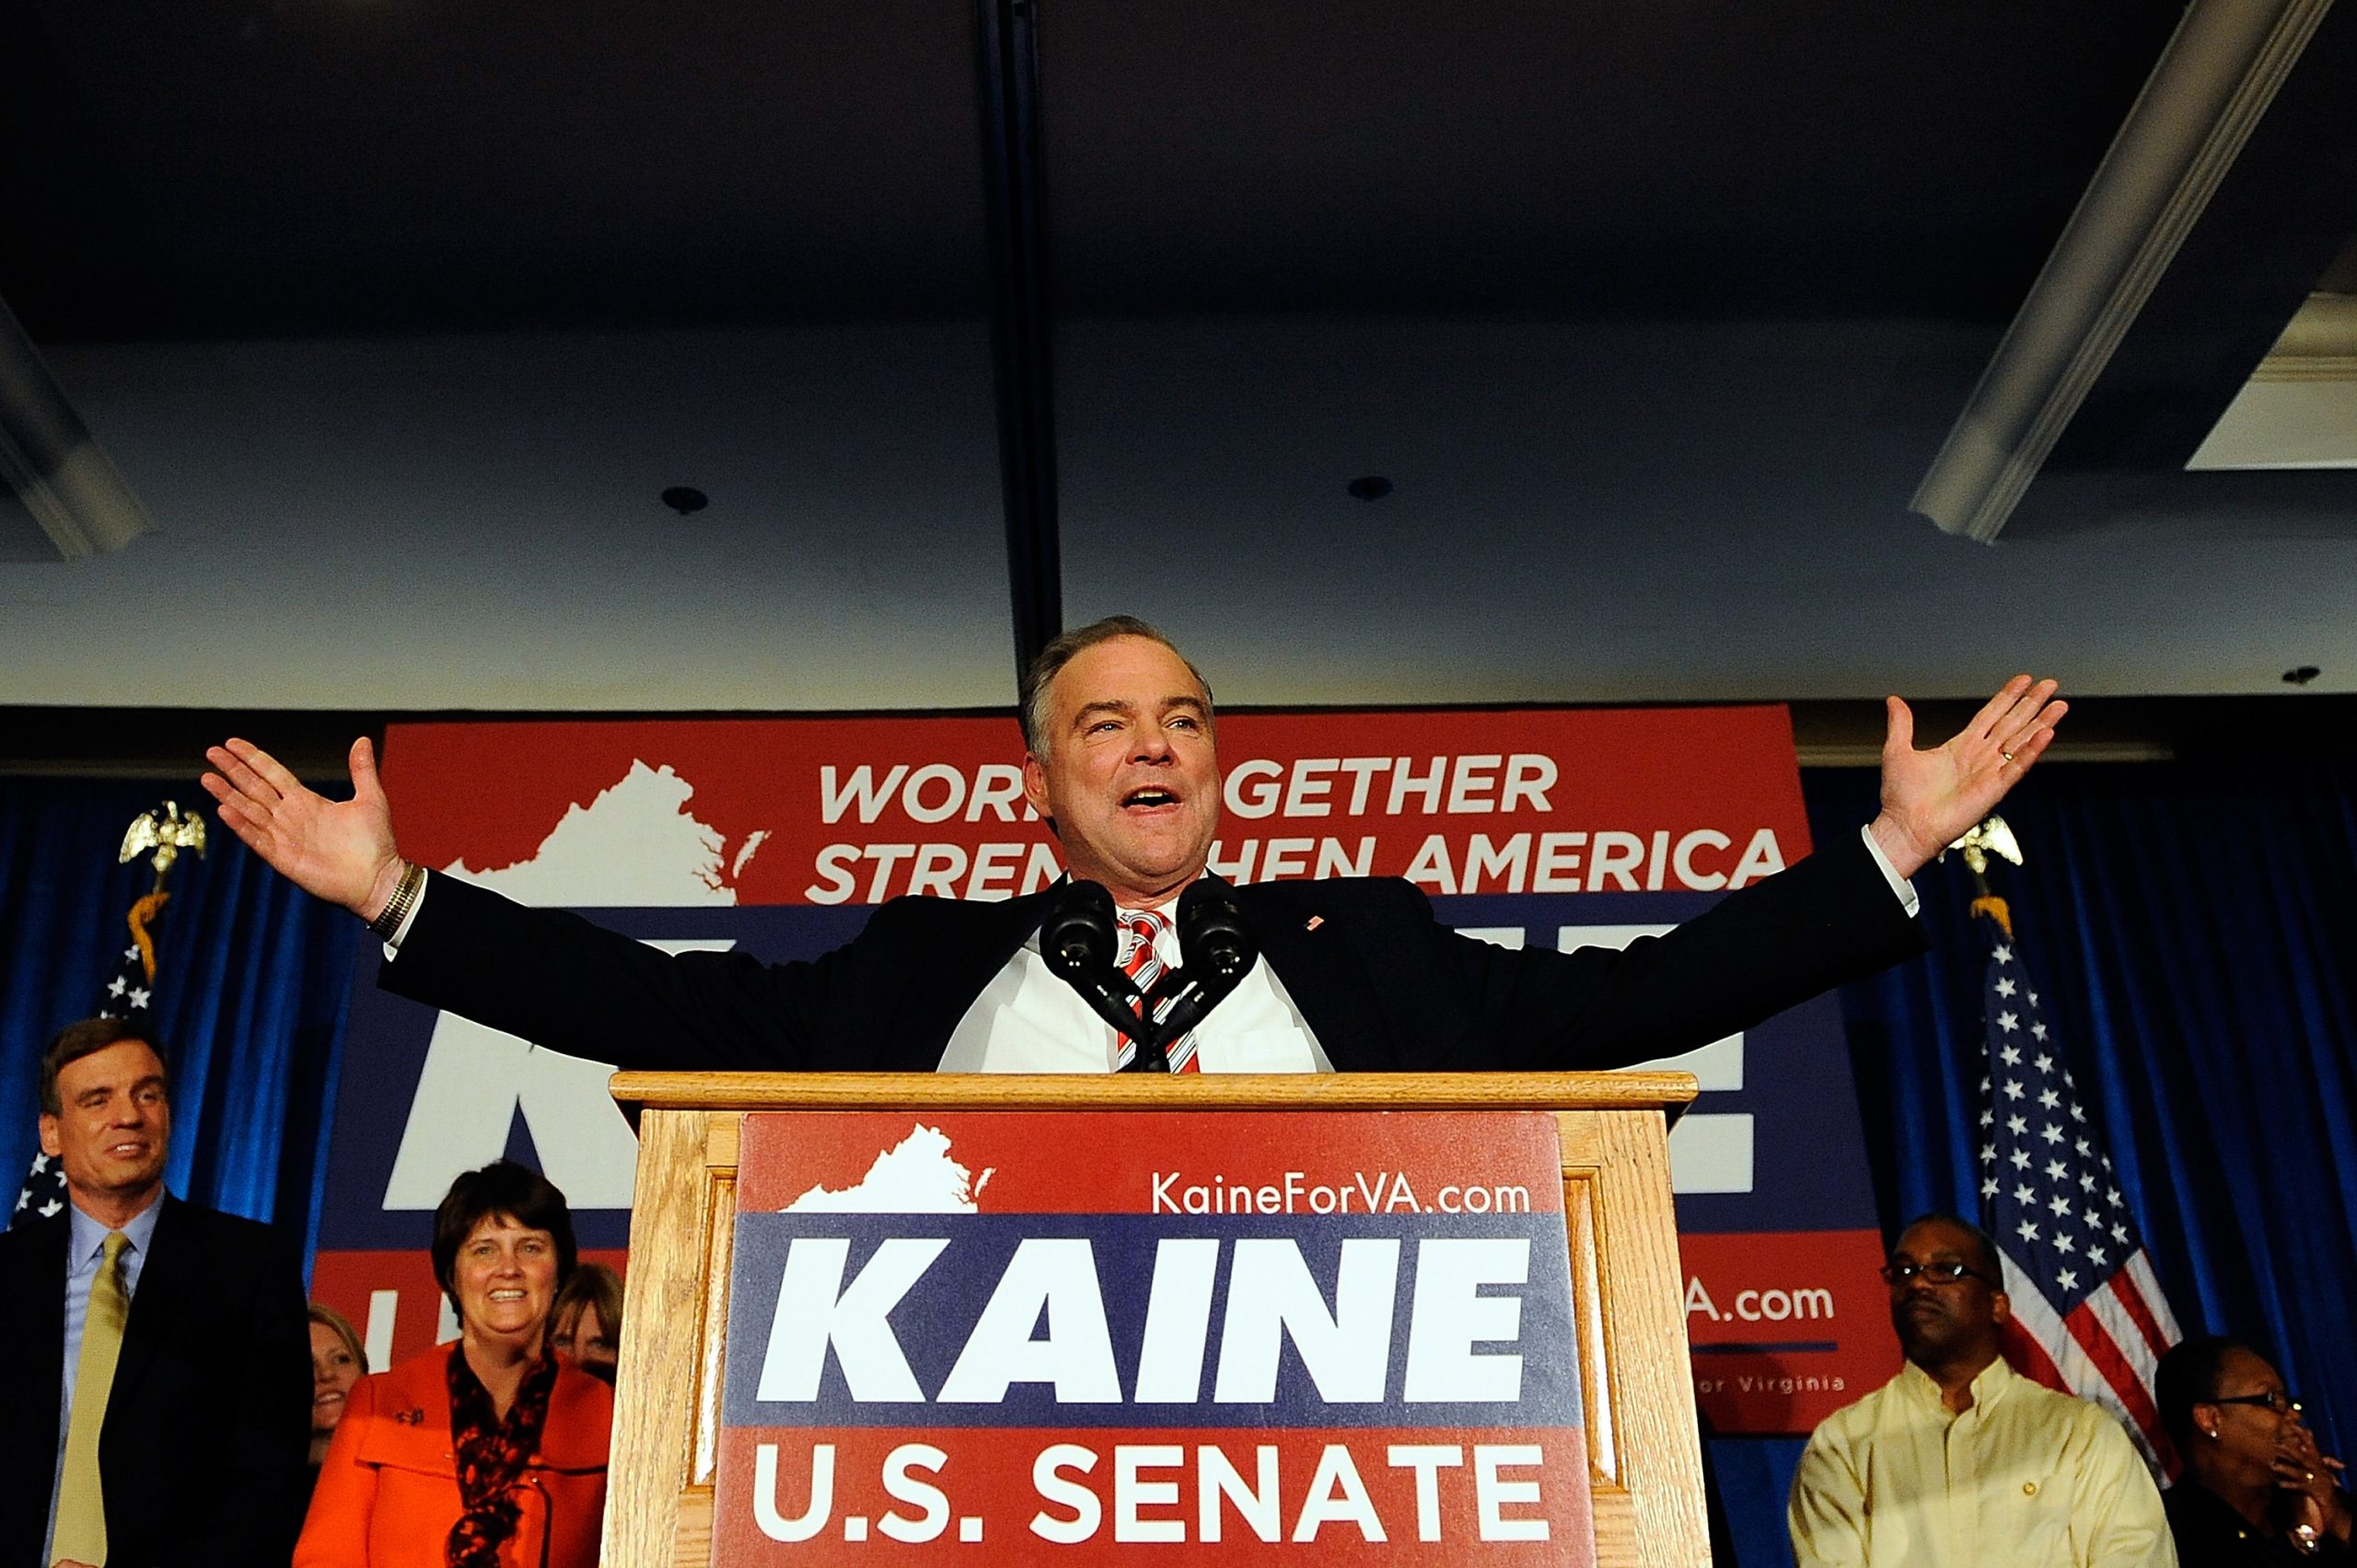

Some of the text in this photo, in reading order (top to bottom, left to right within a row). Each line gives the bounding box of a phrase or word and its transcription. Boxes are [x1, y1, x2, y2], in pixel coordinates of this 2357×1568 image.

[820, 755, 1558, 824] WOR GETHER
[804, 829, 1786, 905] STRENHEN AMERICA
[1151, 1172, 1530, 1216] KaineForVA.com
[756, 1237, 1531, 1404] KAINE
[1698, 1376, 1845, 1396] or Virginia
[750, 1443, 1550, 1543] U.S. SENATE
